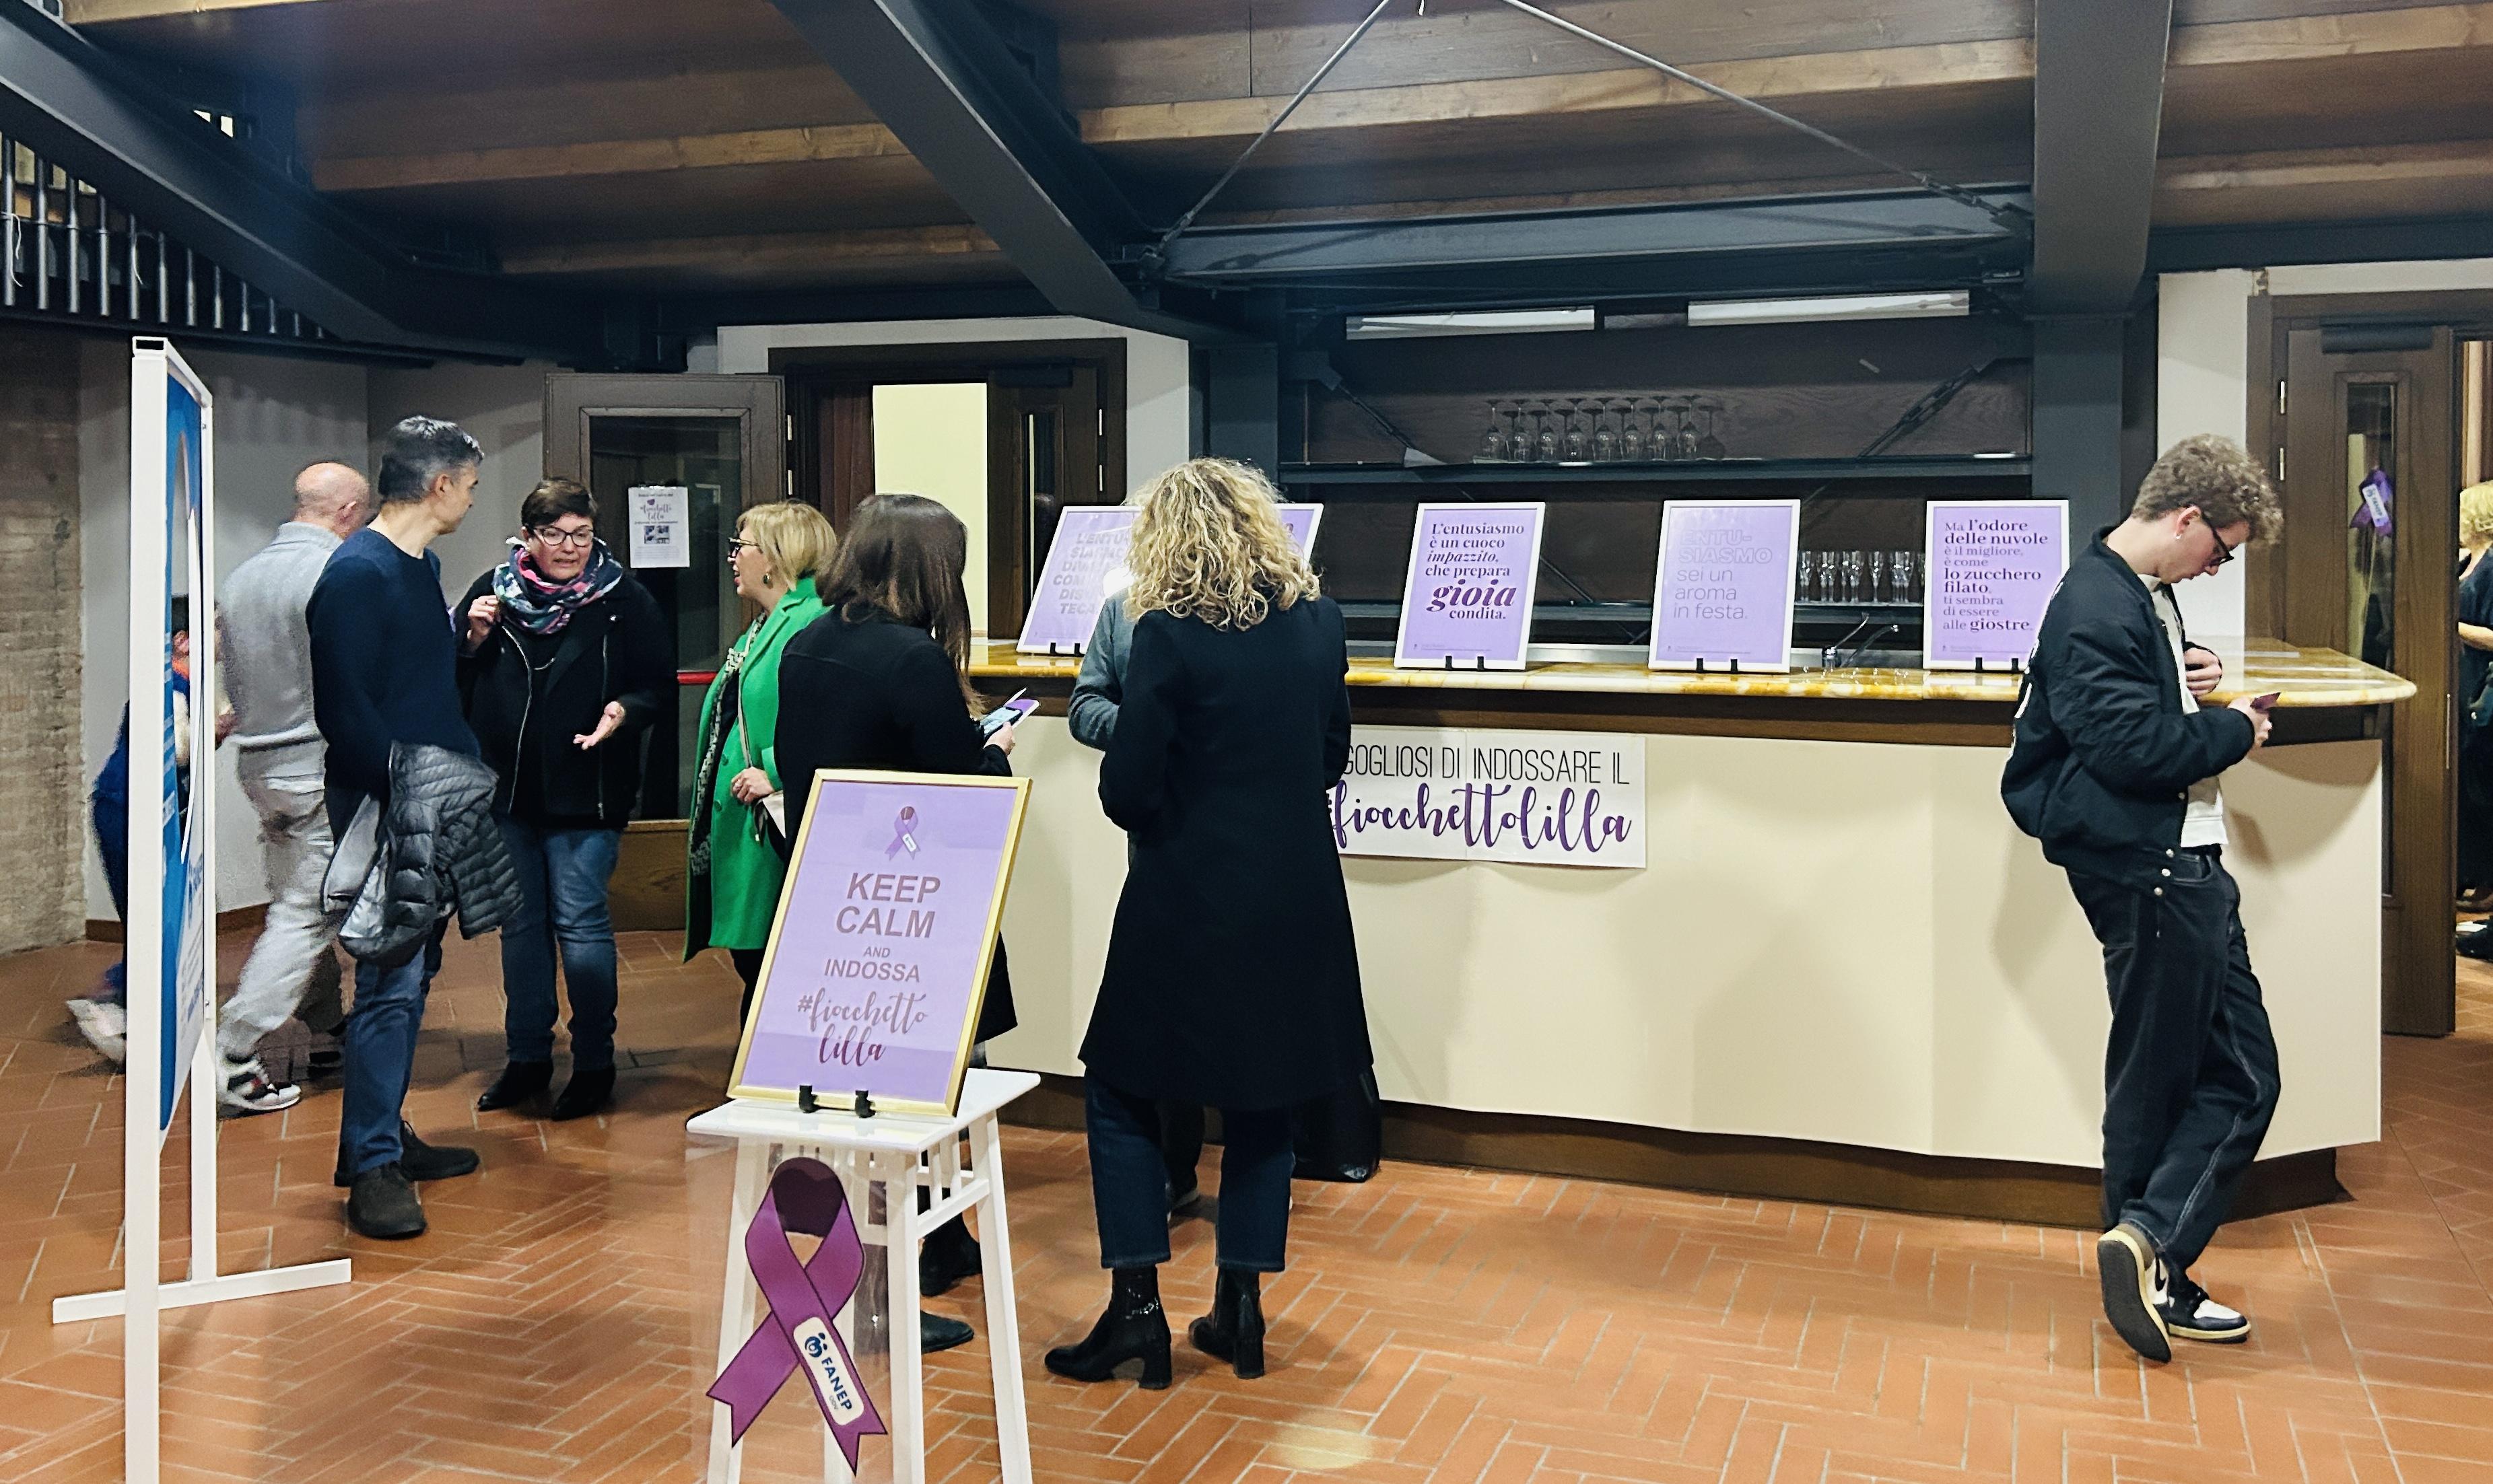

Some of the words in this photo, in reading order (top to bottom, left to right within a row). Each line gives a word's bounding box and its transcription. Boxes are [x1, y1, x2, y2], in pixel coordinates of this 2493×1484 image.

[1432, 522, 1524, 535] L'entusiasmo
[1944, 522, 1964, 531] Ma
[1969, 519, 2028, 532] l'odore
[1429, 536, 1437, 549] è
[1441, 539, 1458, 549] un
[1463, 539, 1505, 549] cuoco
[1680, 529, 1752, 546] ENTU-
[1944, 532, 1986, 544] delle
[1991, 532, 2048, 544] nuvole
[1678, 547, 1773, 564] SIASMO
[1944, 546, 1952, 556] è
[1954, 546, 1962, 556] il
[1944, 558, 1951, 567] è
[1425, 565, 1449, 576] che
[1454, 567, 1510, 579] prepara
[1676, 567, 1704, 582] sei
[1709, 570, 1733, 582] un
[1944, 568, 1960, 580] lo
[1964, 568, 2041, 580] zucchero
[1426, 579, 1517, 612] gioia
[1674, 588, 1737, 600] aroma
[1944, 596, 1952, 605] ti
[1956, 594, 2004, 605] sembra
[1449, 607, 1506, 619] condita.
[1673, 603, 1688, 619] in
[1695, 602, 1748, 619] festa.
[1943, 606, 1955, 616] di
[1958, 608, 2000, 616] essere
[1942, 619, 1967, 630] alle
[1344, 744, 1433, 778] GOGLIOSI
[1442, 747, 1460, 779] DI
[1473, 748, 1602, 784] INDOSSARE
[1612, 752, 1630, 785] IL
[846, 872, 941, 903] KEEP
[836, 905, 936, 938] CALM
[863, 946, 891, 958] AND
[824, 958, 920, 983] INDOSSA
[797, 987, 929, 1034] #fiocchetto
[819, 1023, 887, 1067] lilla
[821, 1357, 853, 1410] FANEP
